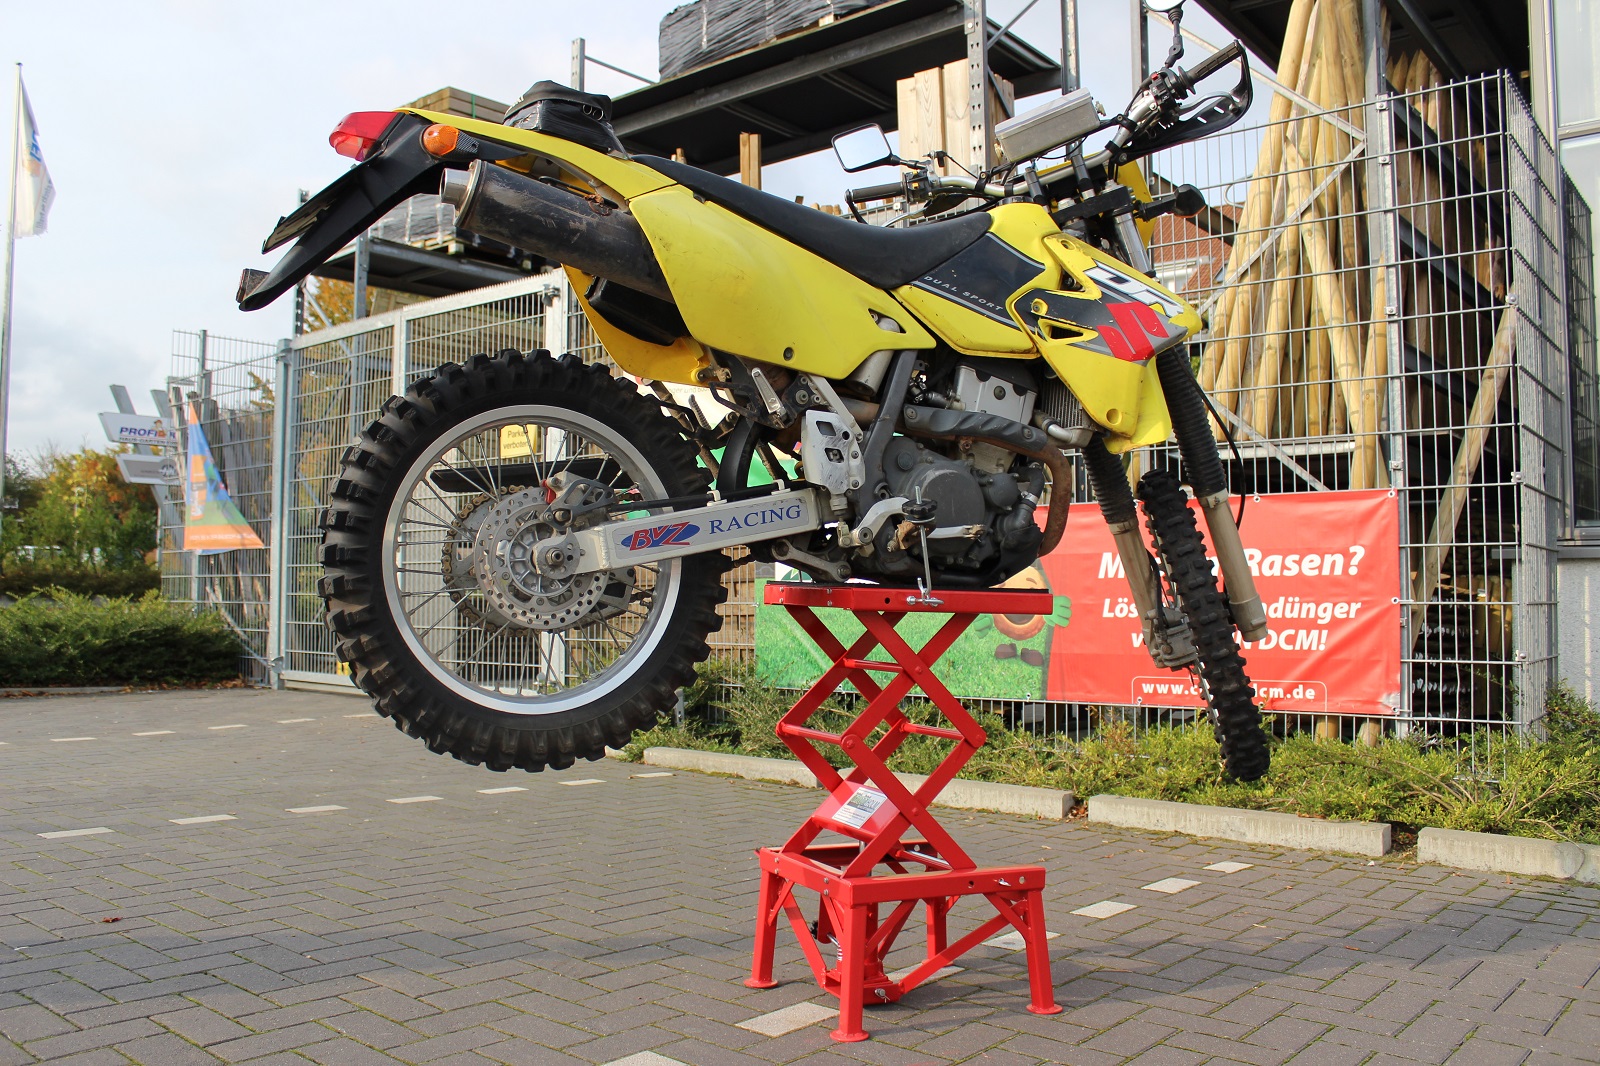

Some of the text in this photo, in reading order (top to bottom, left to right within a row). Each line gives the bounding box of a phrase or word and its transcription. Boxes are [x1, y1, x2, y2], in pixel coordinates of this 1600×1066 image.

[923, 275, 1004, 311] DUAL SPORT
[507, 429, 528, 439] Parke
[708, 504, 802, 535] RACING
[1243, 545, 1366, 577] Rasen?
[1258, 629, 1329, 651] DCM!
